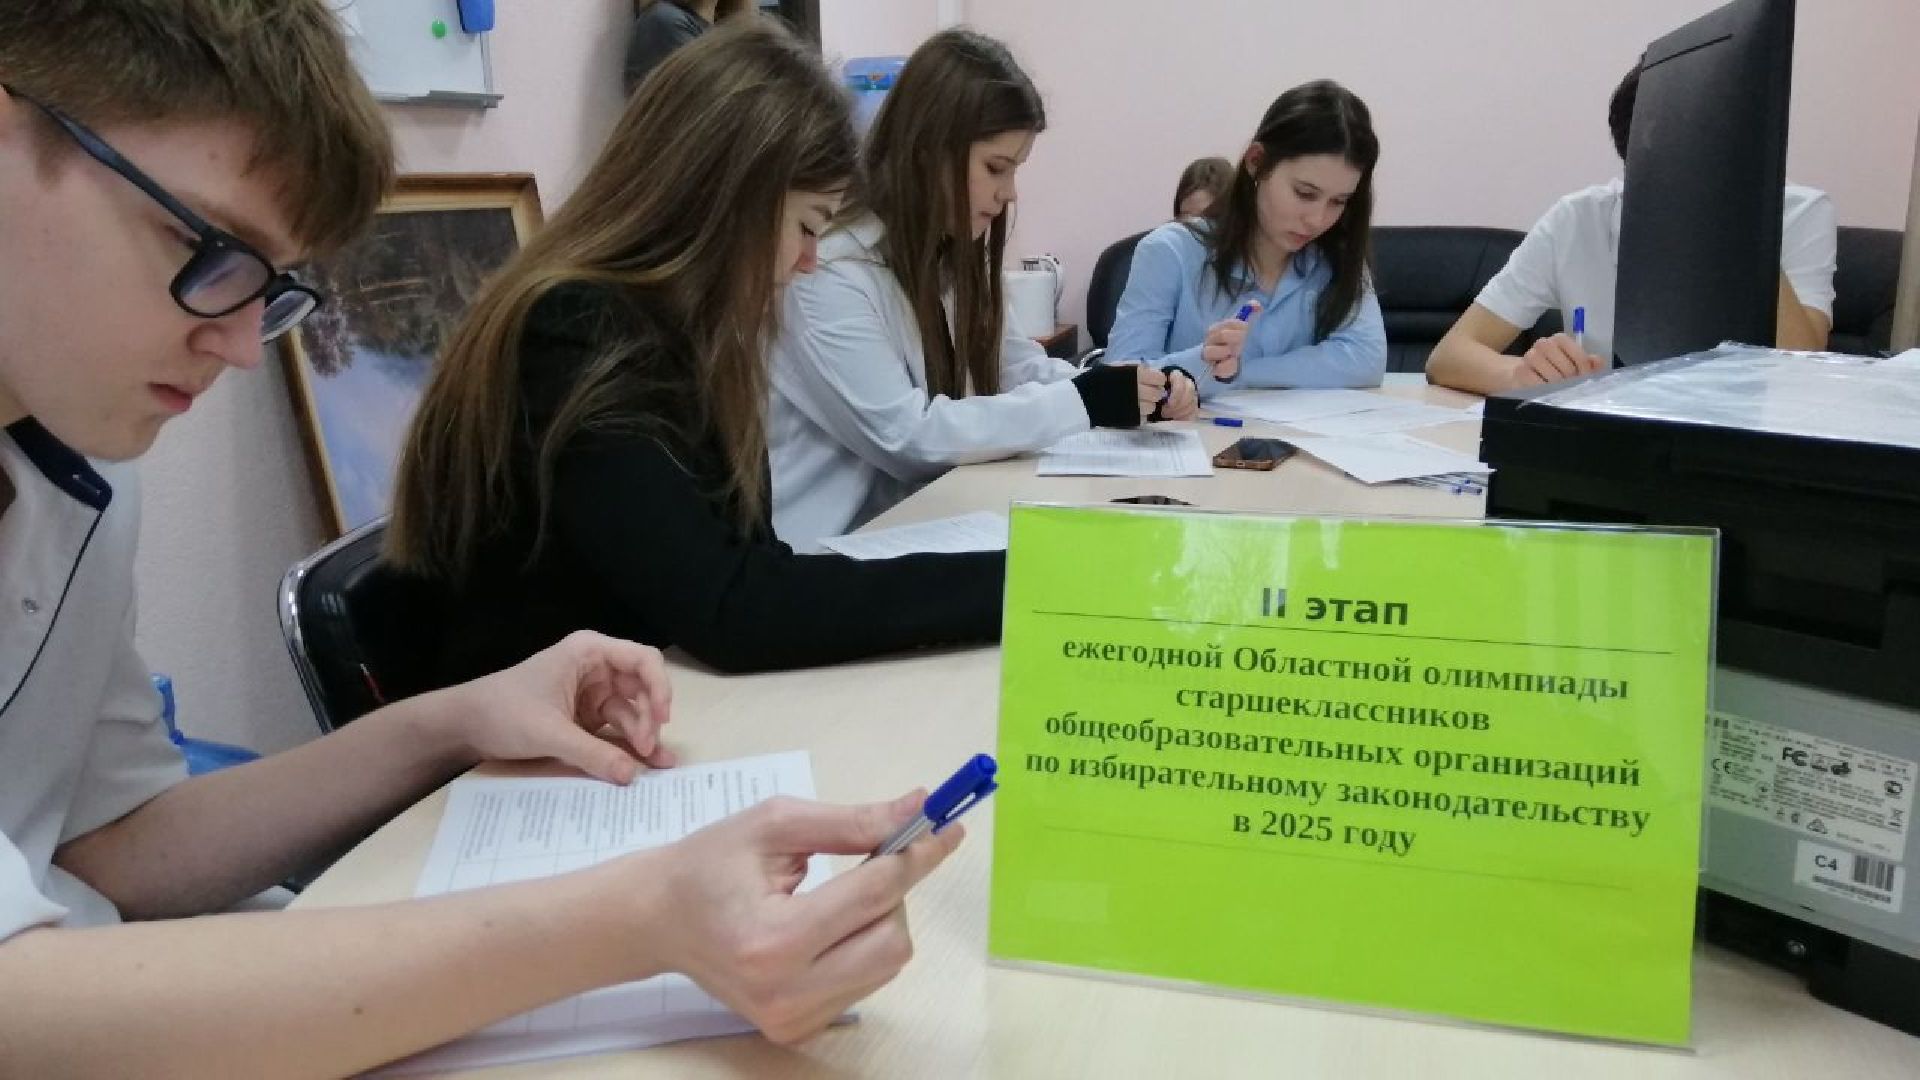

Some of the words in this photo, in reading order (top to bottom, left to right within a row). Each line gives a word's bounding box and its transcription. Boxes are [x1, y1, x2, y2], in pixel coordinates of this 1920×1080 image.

[1305, 597, 1409, 626] этап
[1062, 639, 1224, 671] ежегодной
[1233, 646, 1412, 684] Областной
[1422, 667, 1629, 704] олимпиады
[1175, 688, 1491, 732] старшеклассников
[1044, 711, 1404, 767] общеобразовательных
[1413, 750, 1641, 789] организаций
[1025, 753, 1060, 775] по
[1068, 753, 1328, 805] избирательному
[1336, 783, 1651, 838] законодательству
[1232, 813, 1252, 833] в
[1260, 810, 1333, 843] 2025
[1343, 825, 1417, 857] году
[1814, 854, 1838, 872] C4
